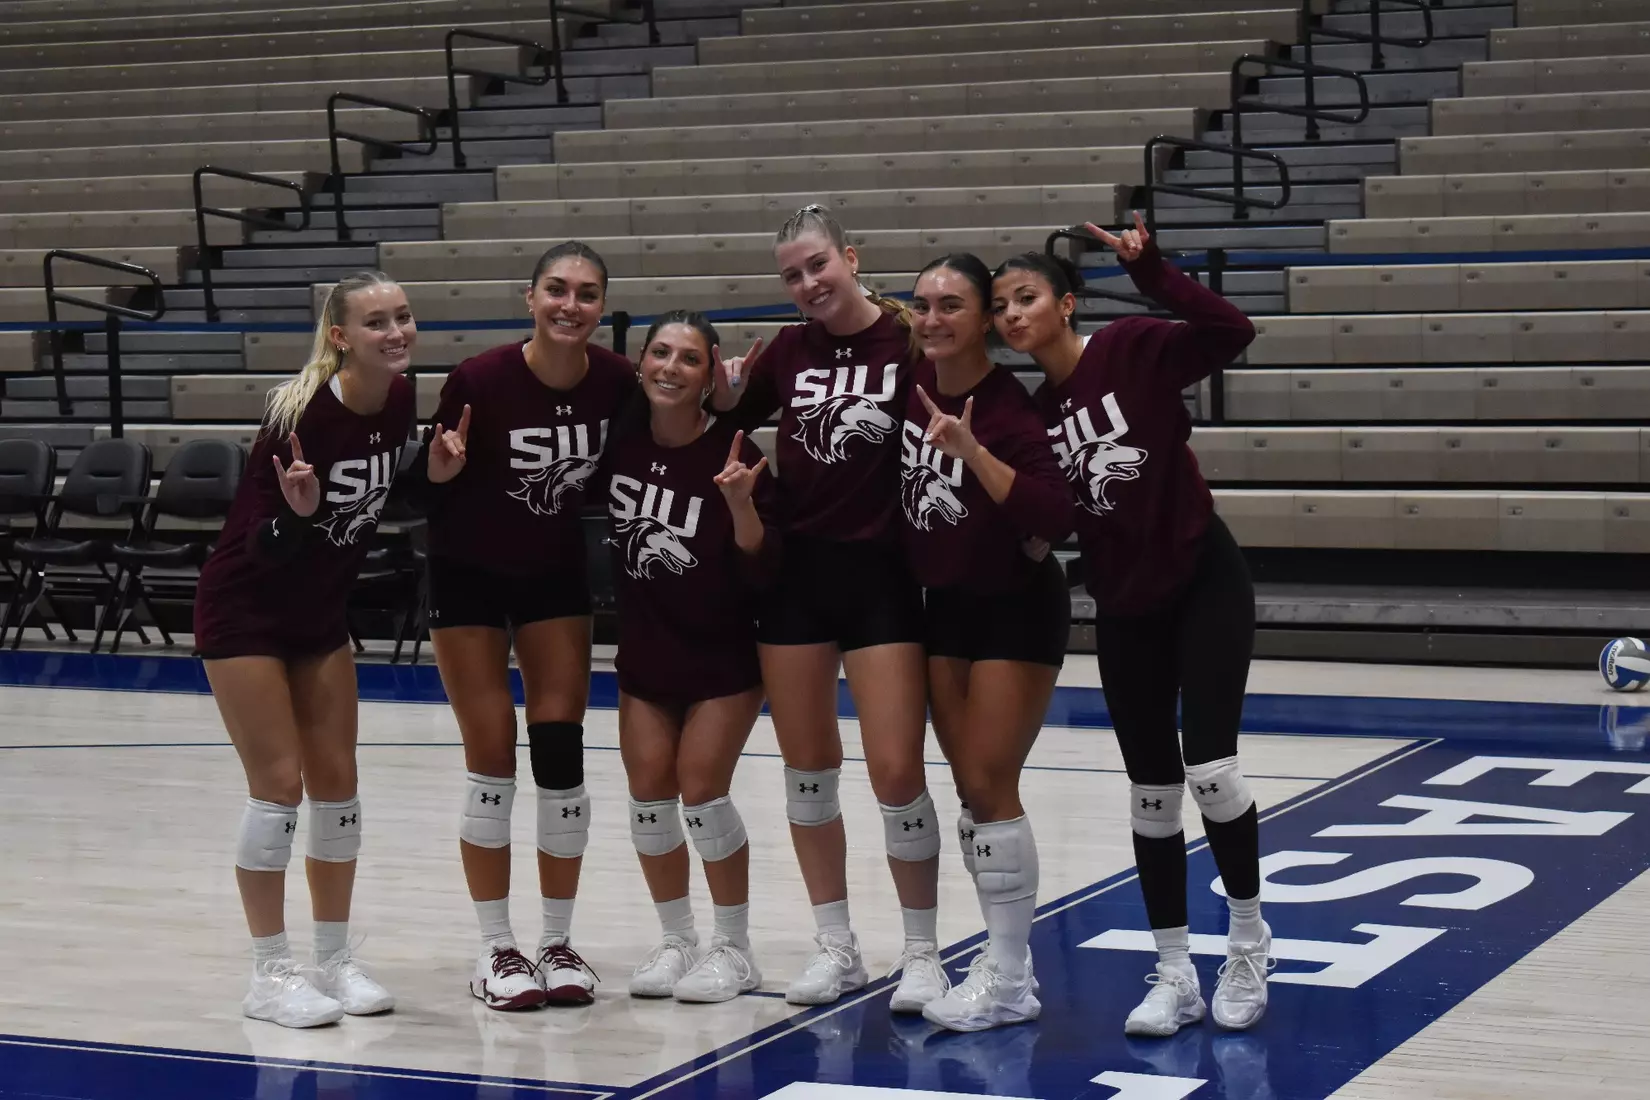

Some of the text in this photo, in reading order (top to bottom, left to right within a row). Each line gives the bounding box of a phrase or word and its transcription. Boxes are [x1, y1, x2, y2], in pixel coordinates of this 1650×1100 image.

[790, 363, 899, 408] SIU
[509, 418, 609, 470] SIU
[608, 474, 704, 538] SIU
[1076, 755, 1650, 989] EAST
